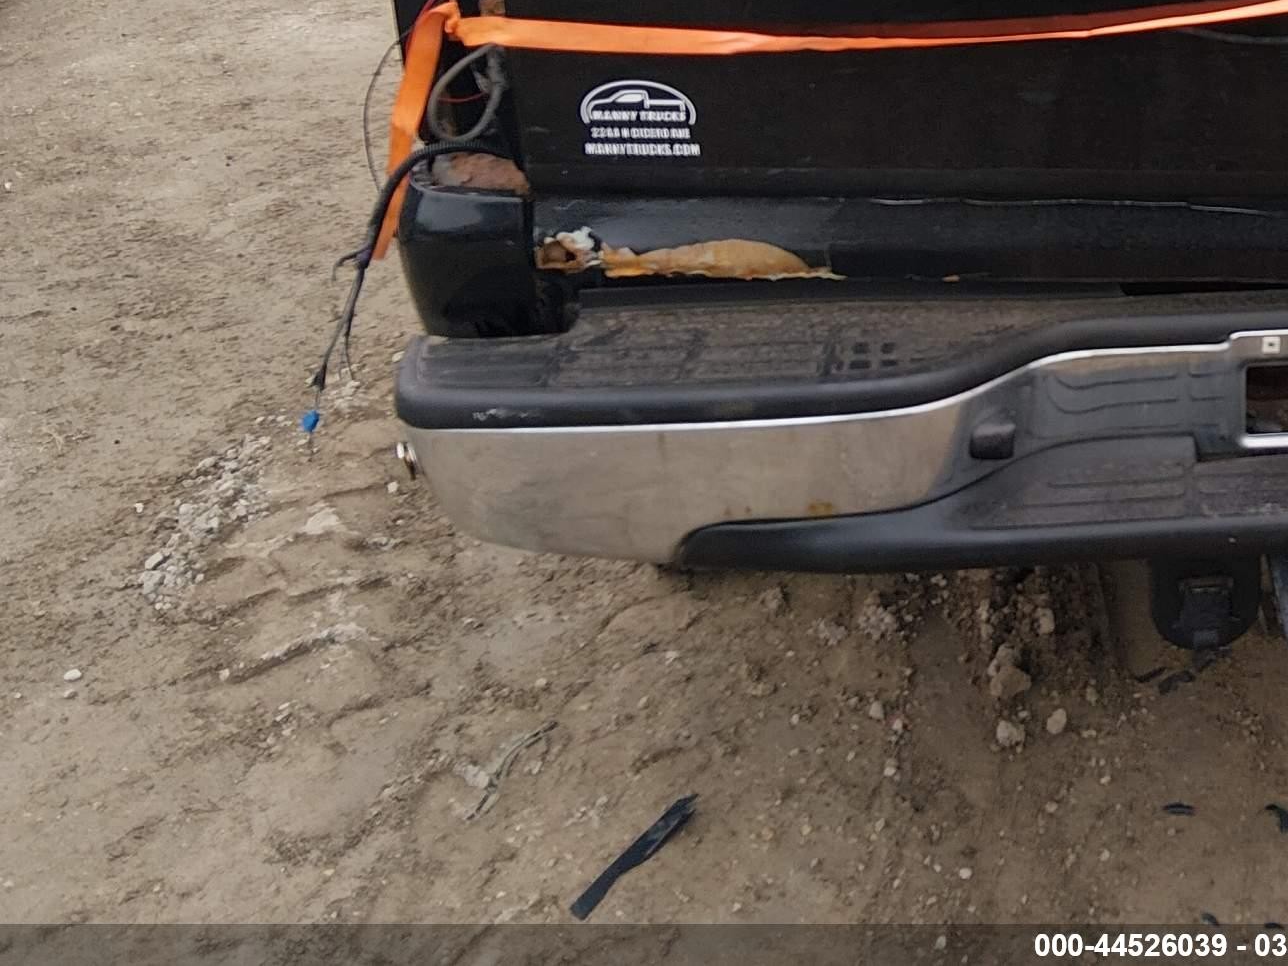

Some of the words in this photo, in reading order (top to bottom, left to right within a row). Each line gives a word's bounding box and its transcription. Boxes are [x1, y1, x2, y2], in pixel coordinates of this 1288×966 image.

[591, 110, 638, 121] MANNY
[639, 110, 686, 122] TRUCKS
[621, 127, 630, 138] N
[630, 127, 670, 138] CICERO
[670, 128, 690, 139] AVE
[584, 142, 701, 155] MANNYTRUCKS.COM
